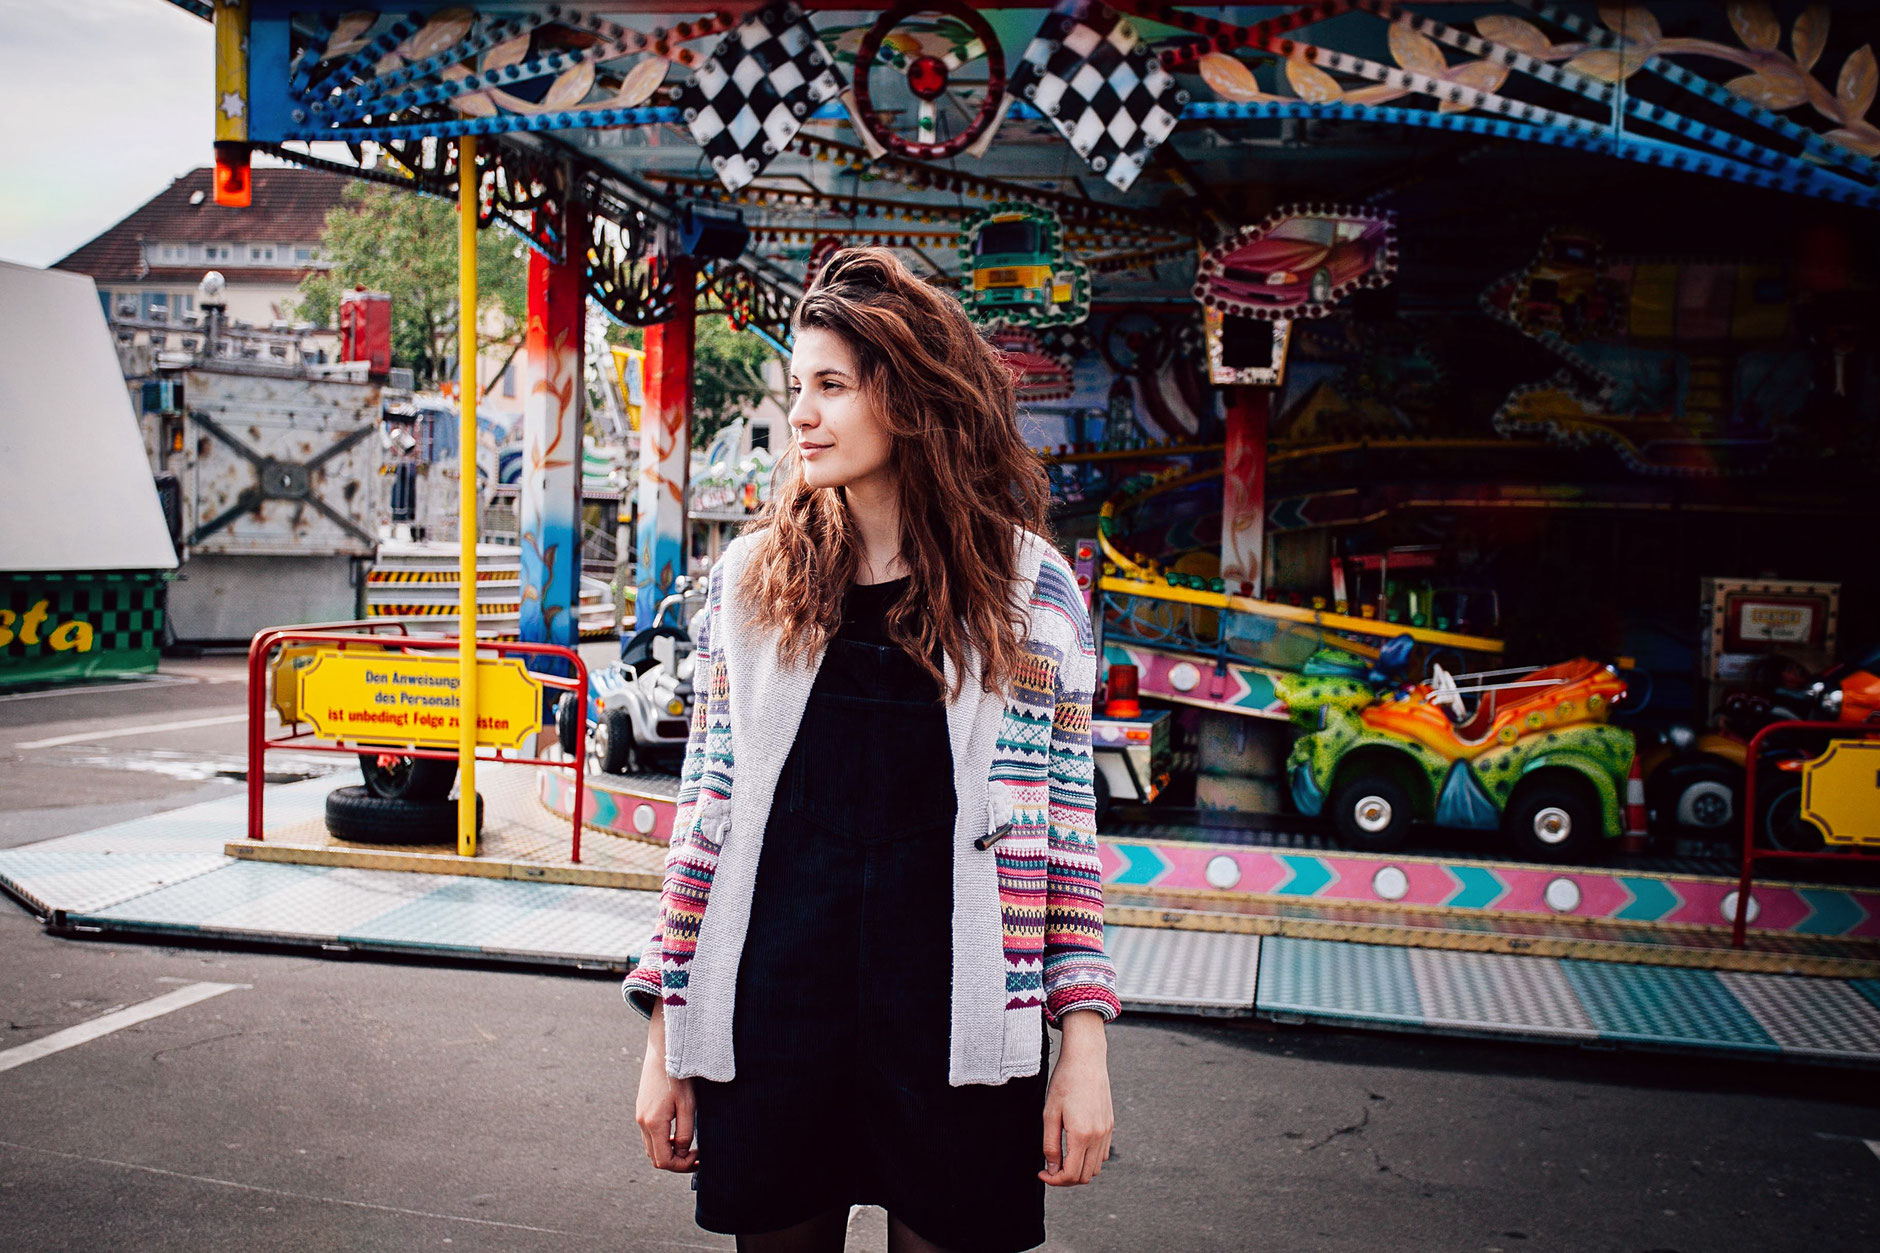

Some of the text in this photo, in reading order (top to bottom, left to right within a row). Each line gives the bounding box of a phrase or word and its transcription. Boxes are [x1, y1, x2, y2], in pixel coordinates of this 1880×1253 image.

[365, 670, 387, 684] Den
[374, 690, 396, 704] des
[328, 707, 344, 722] ist
[348, 710, 408, 727] unbedingt
[413, 711, 444, 728] Folge
